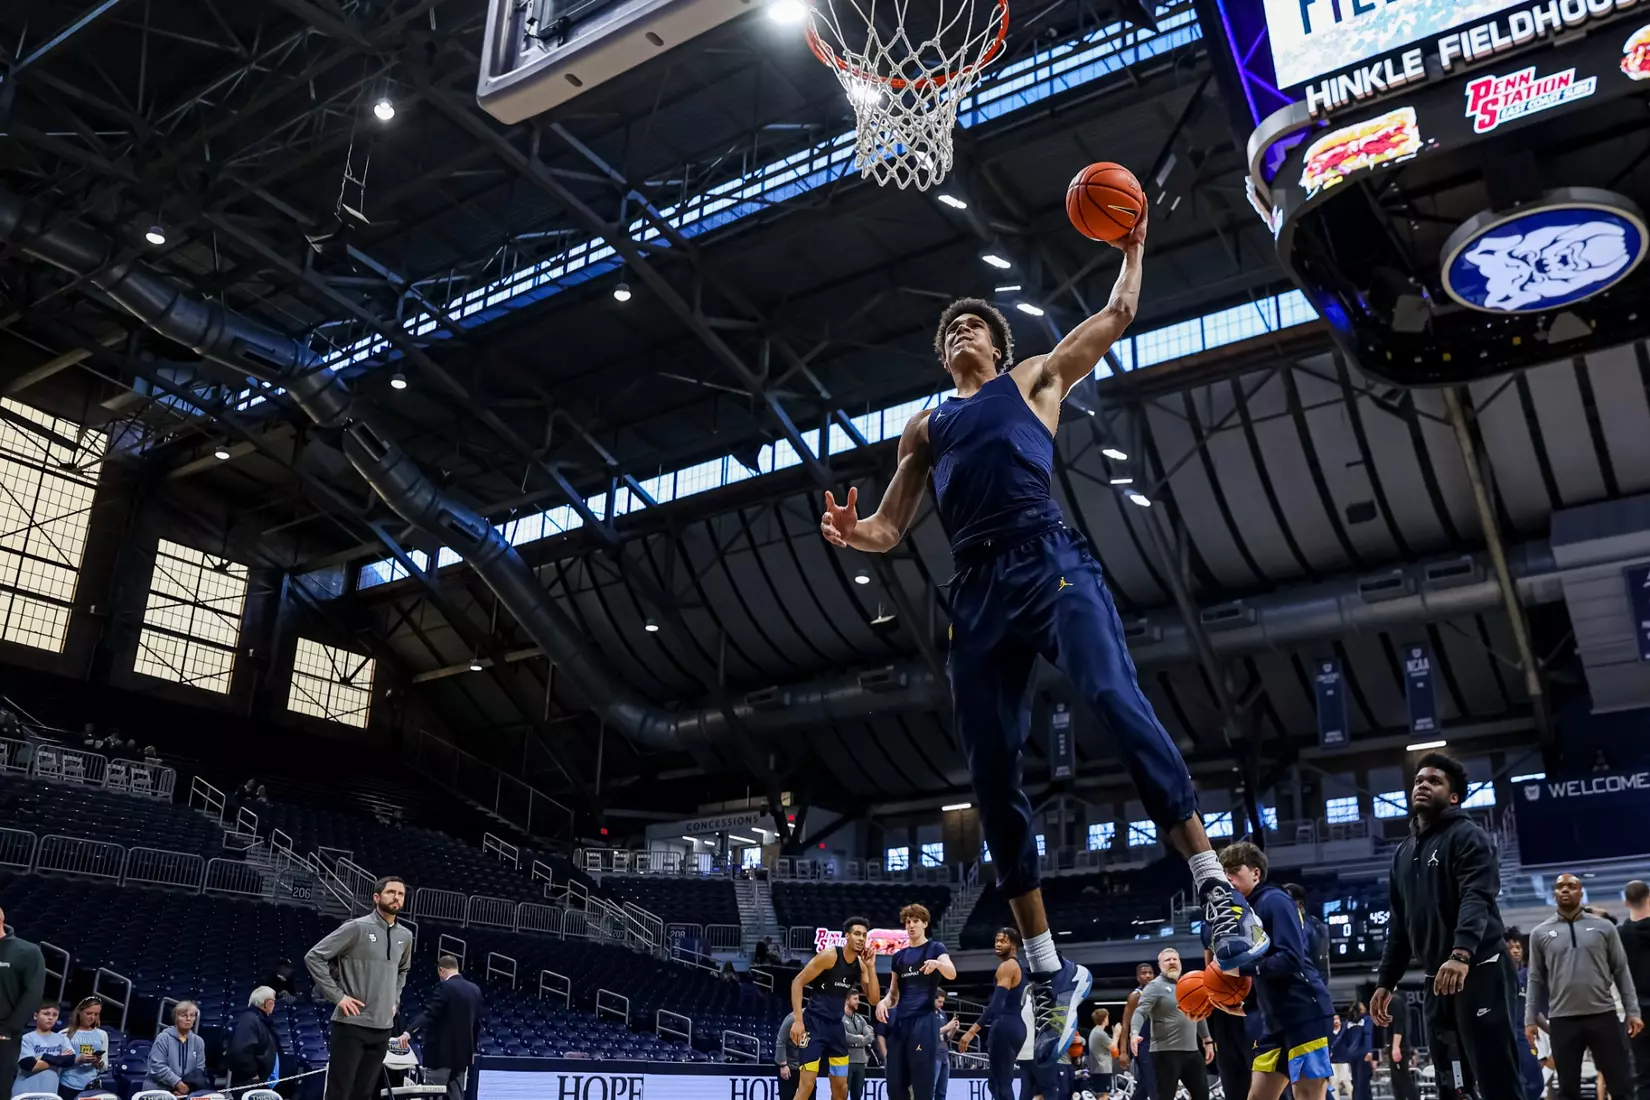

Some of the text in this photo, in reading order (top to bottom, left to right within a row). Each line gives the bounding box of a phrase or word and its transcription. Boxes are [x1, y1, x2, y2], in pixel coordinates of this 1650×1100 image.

[1305, 48, 1426, 117] HINKLE
[1437, 0, 1648, 72] FIELDHOU
[1470, 71, 1531, 112] PENN
[1478, 73, 1571, 130] STATION
[1547, 772, 1650, 798] WELCOME
[686, 814, 759, 832] CONCESSIONS
[292, 886, 311, 899] 206
[817, 930, 841, 943] PENN
[557, 1075, 644, 1100] HOPE
[729, 1078, 780, 1100] HOP
